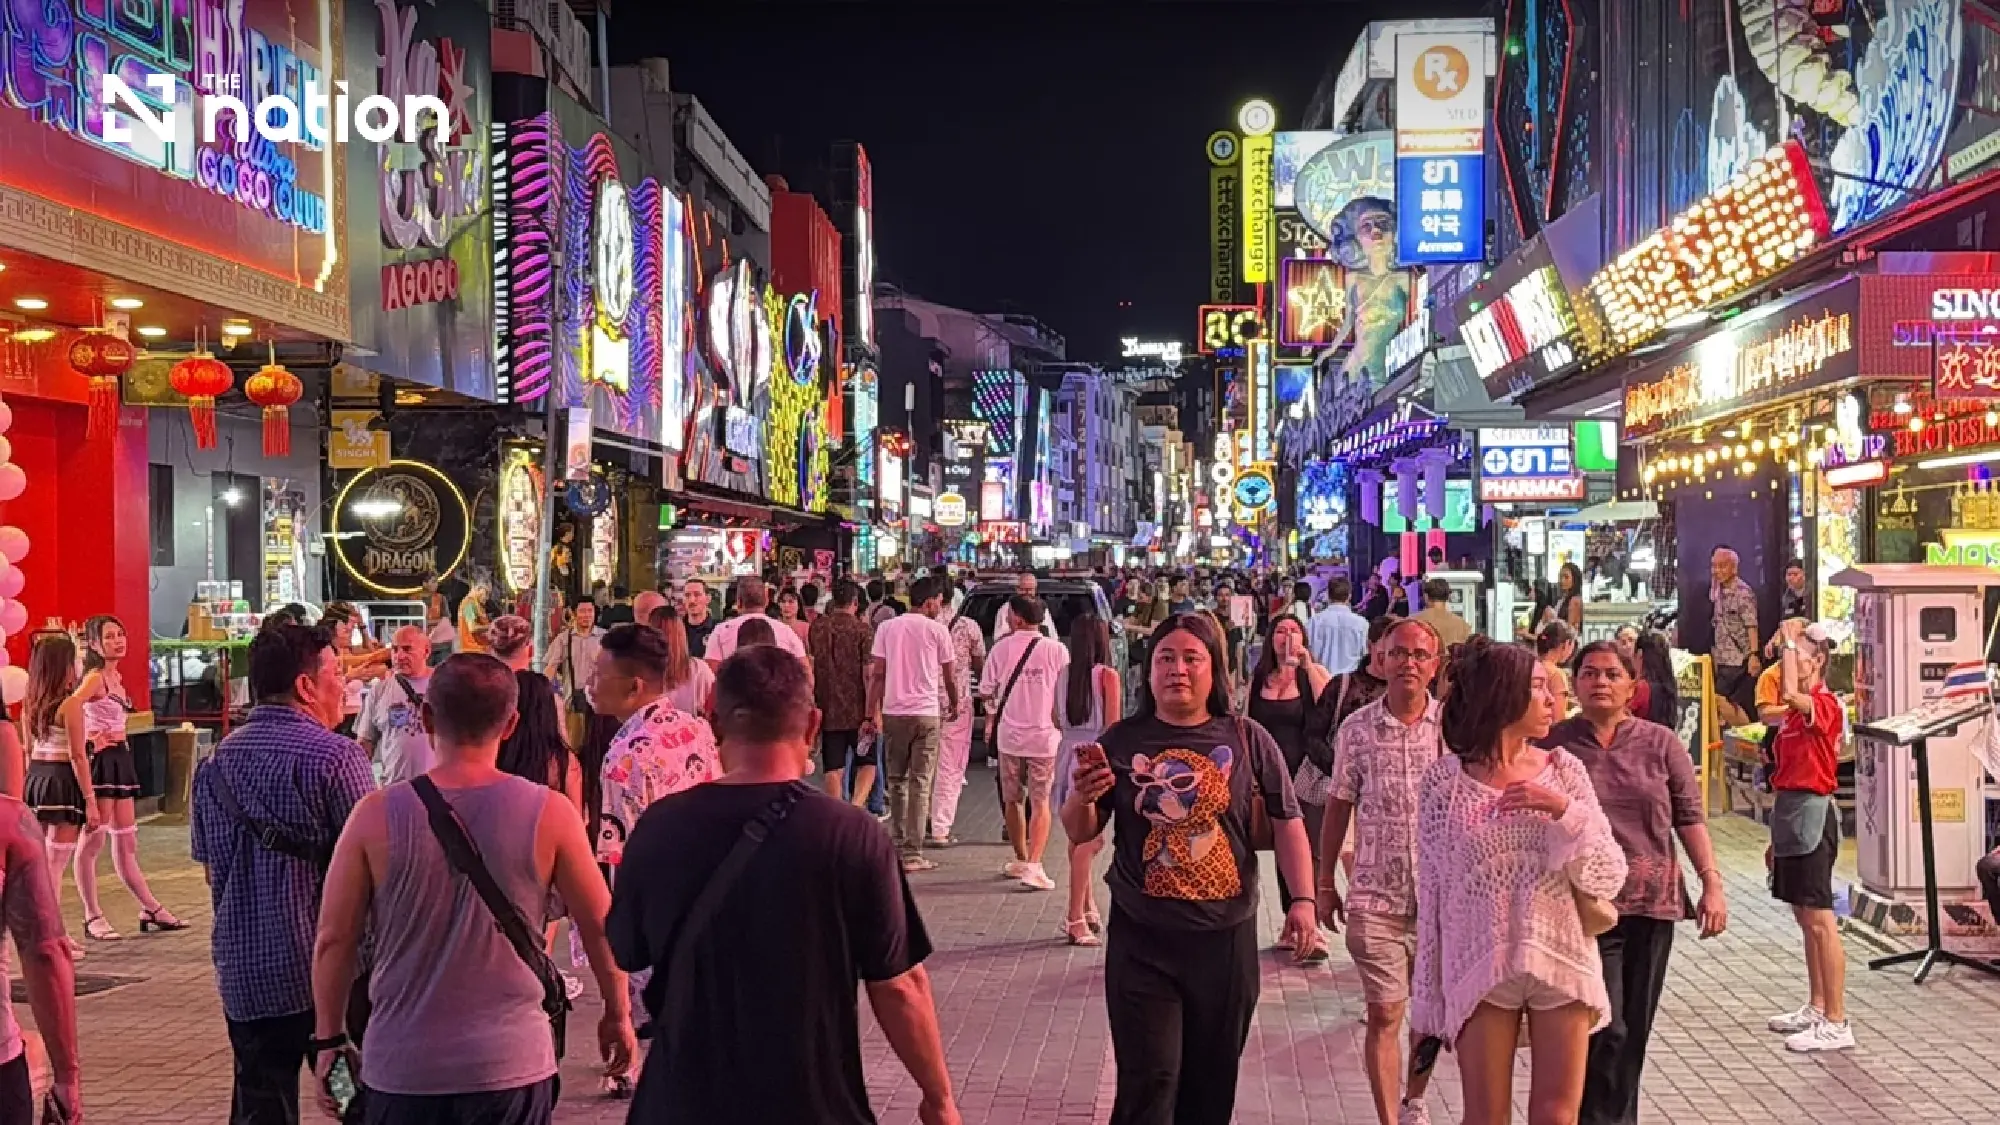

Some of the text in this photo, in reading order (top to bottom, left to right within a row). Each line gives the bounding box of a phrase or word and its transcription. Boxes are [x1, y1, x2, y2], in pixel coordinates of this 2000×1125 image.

[197, 146, 272, 210] GOGO
[274, 179, 327, 233] CLUB
[384, 259, 459, 311] AGOGO
[1510, 448, 1547, 475] ยา
[1485, 480, 1580, 498] PHARMACY
[367, 550, 437, 575] DRAGON
